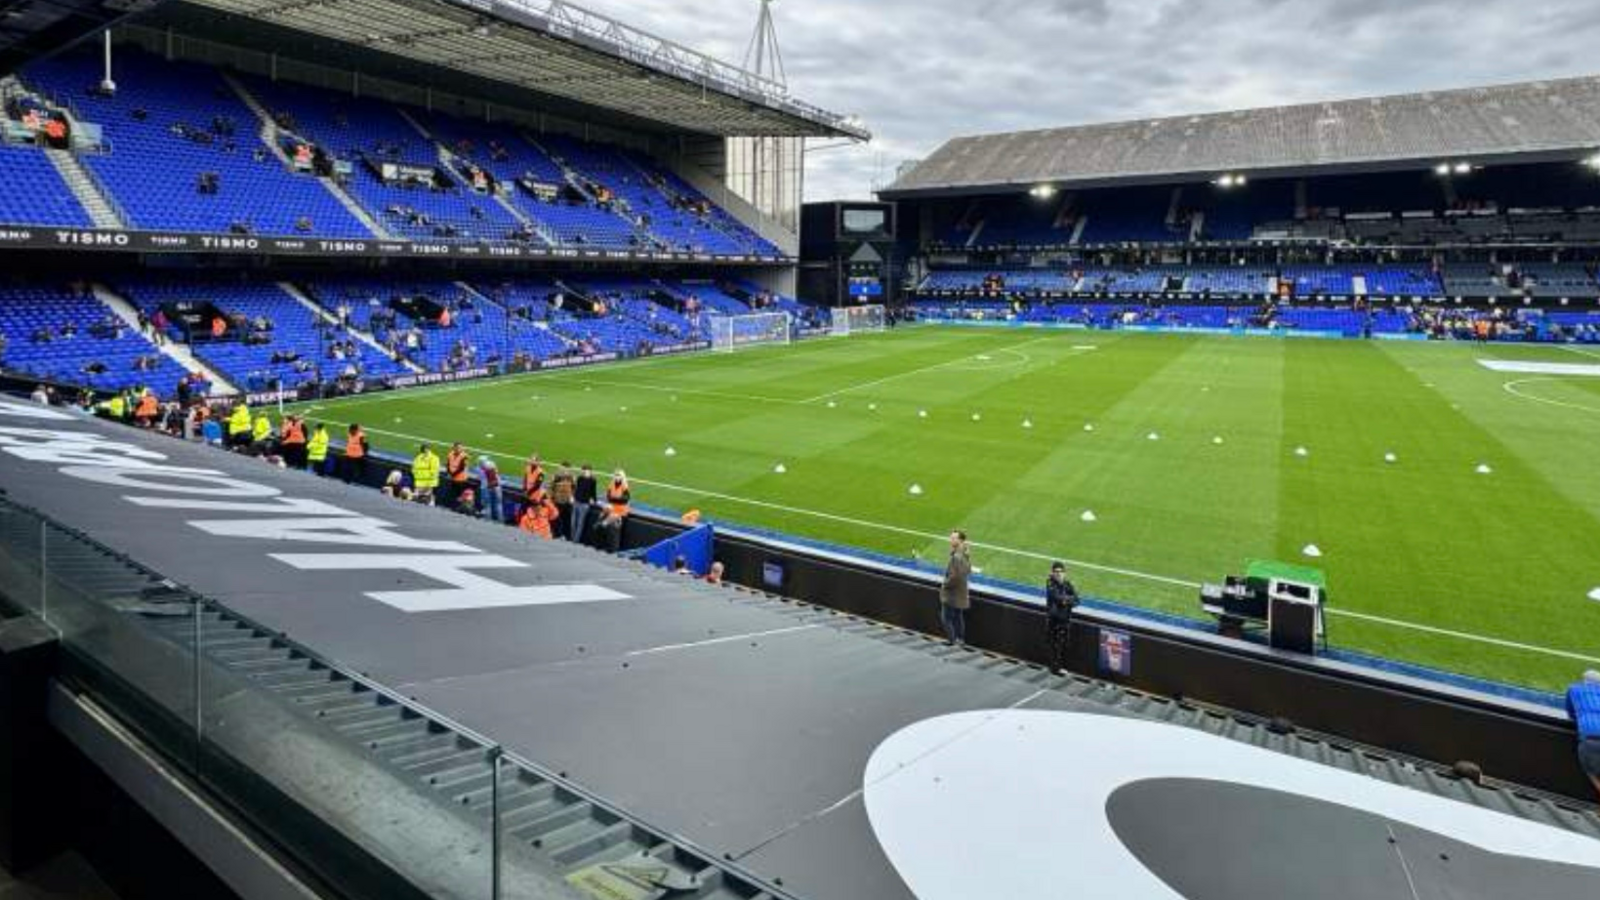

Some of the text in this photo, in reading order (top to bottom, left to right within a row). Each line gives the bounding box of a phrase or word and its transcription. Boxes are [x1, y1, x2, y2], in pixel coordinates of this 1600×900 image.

[56, 231, 129, 244] TISMO
[201, 236, 258, 249] TISMO
[319, 241, 365, 251] TISMO
[412, 244, 449, 253] TISMO
